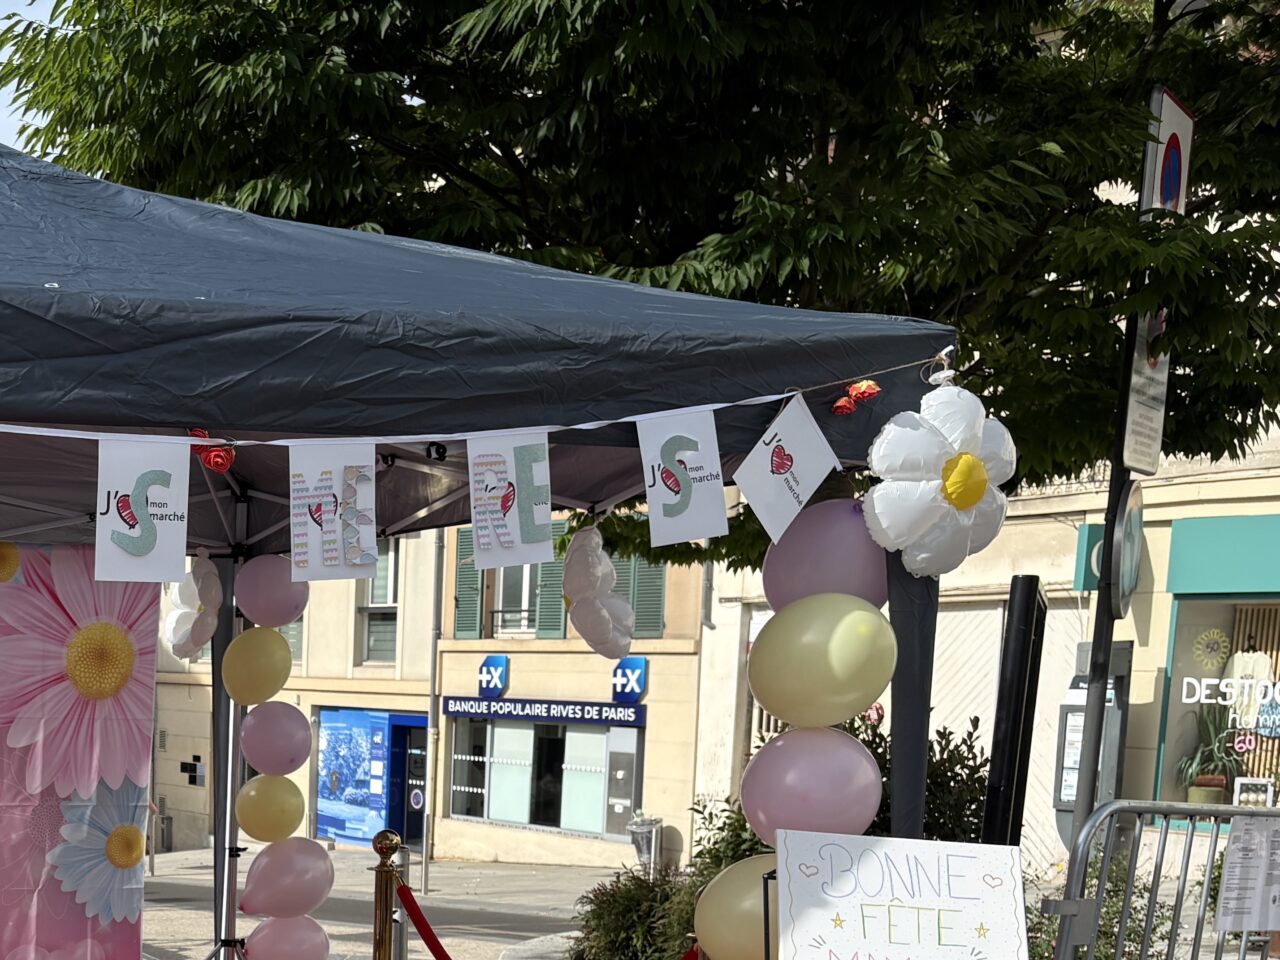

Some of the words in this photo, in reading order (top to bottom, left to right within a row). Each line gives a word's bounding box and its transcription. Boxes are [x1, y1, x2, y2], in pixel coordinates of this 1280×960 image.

[688, 465, 704, 473] mon
[150, 500, 168, 509] mon
[1182, 677, 1280, 706] DESTO
[448, 700, 488, 714] BANQUE
[490, 701, 548, 717] POPULAIRE
[550, 703, 582, 719] RIVES
[584, 705, 600, 719] DE
[602, 706, 636, 722] PARIS
[818, 843, 981, 901] BONNE
[859, 896, 968, 947] FÊTE
